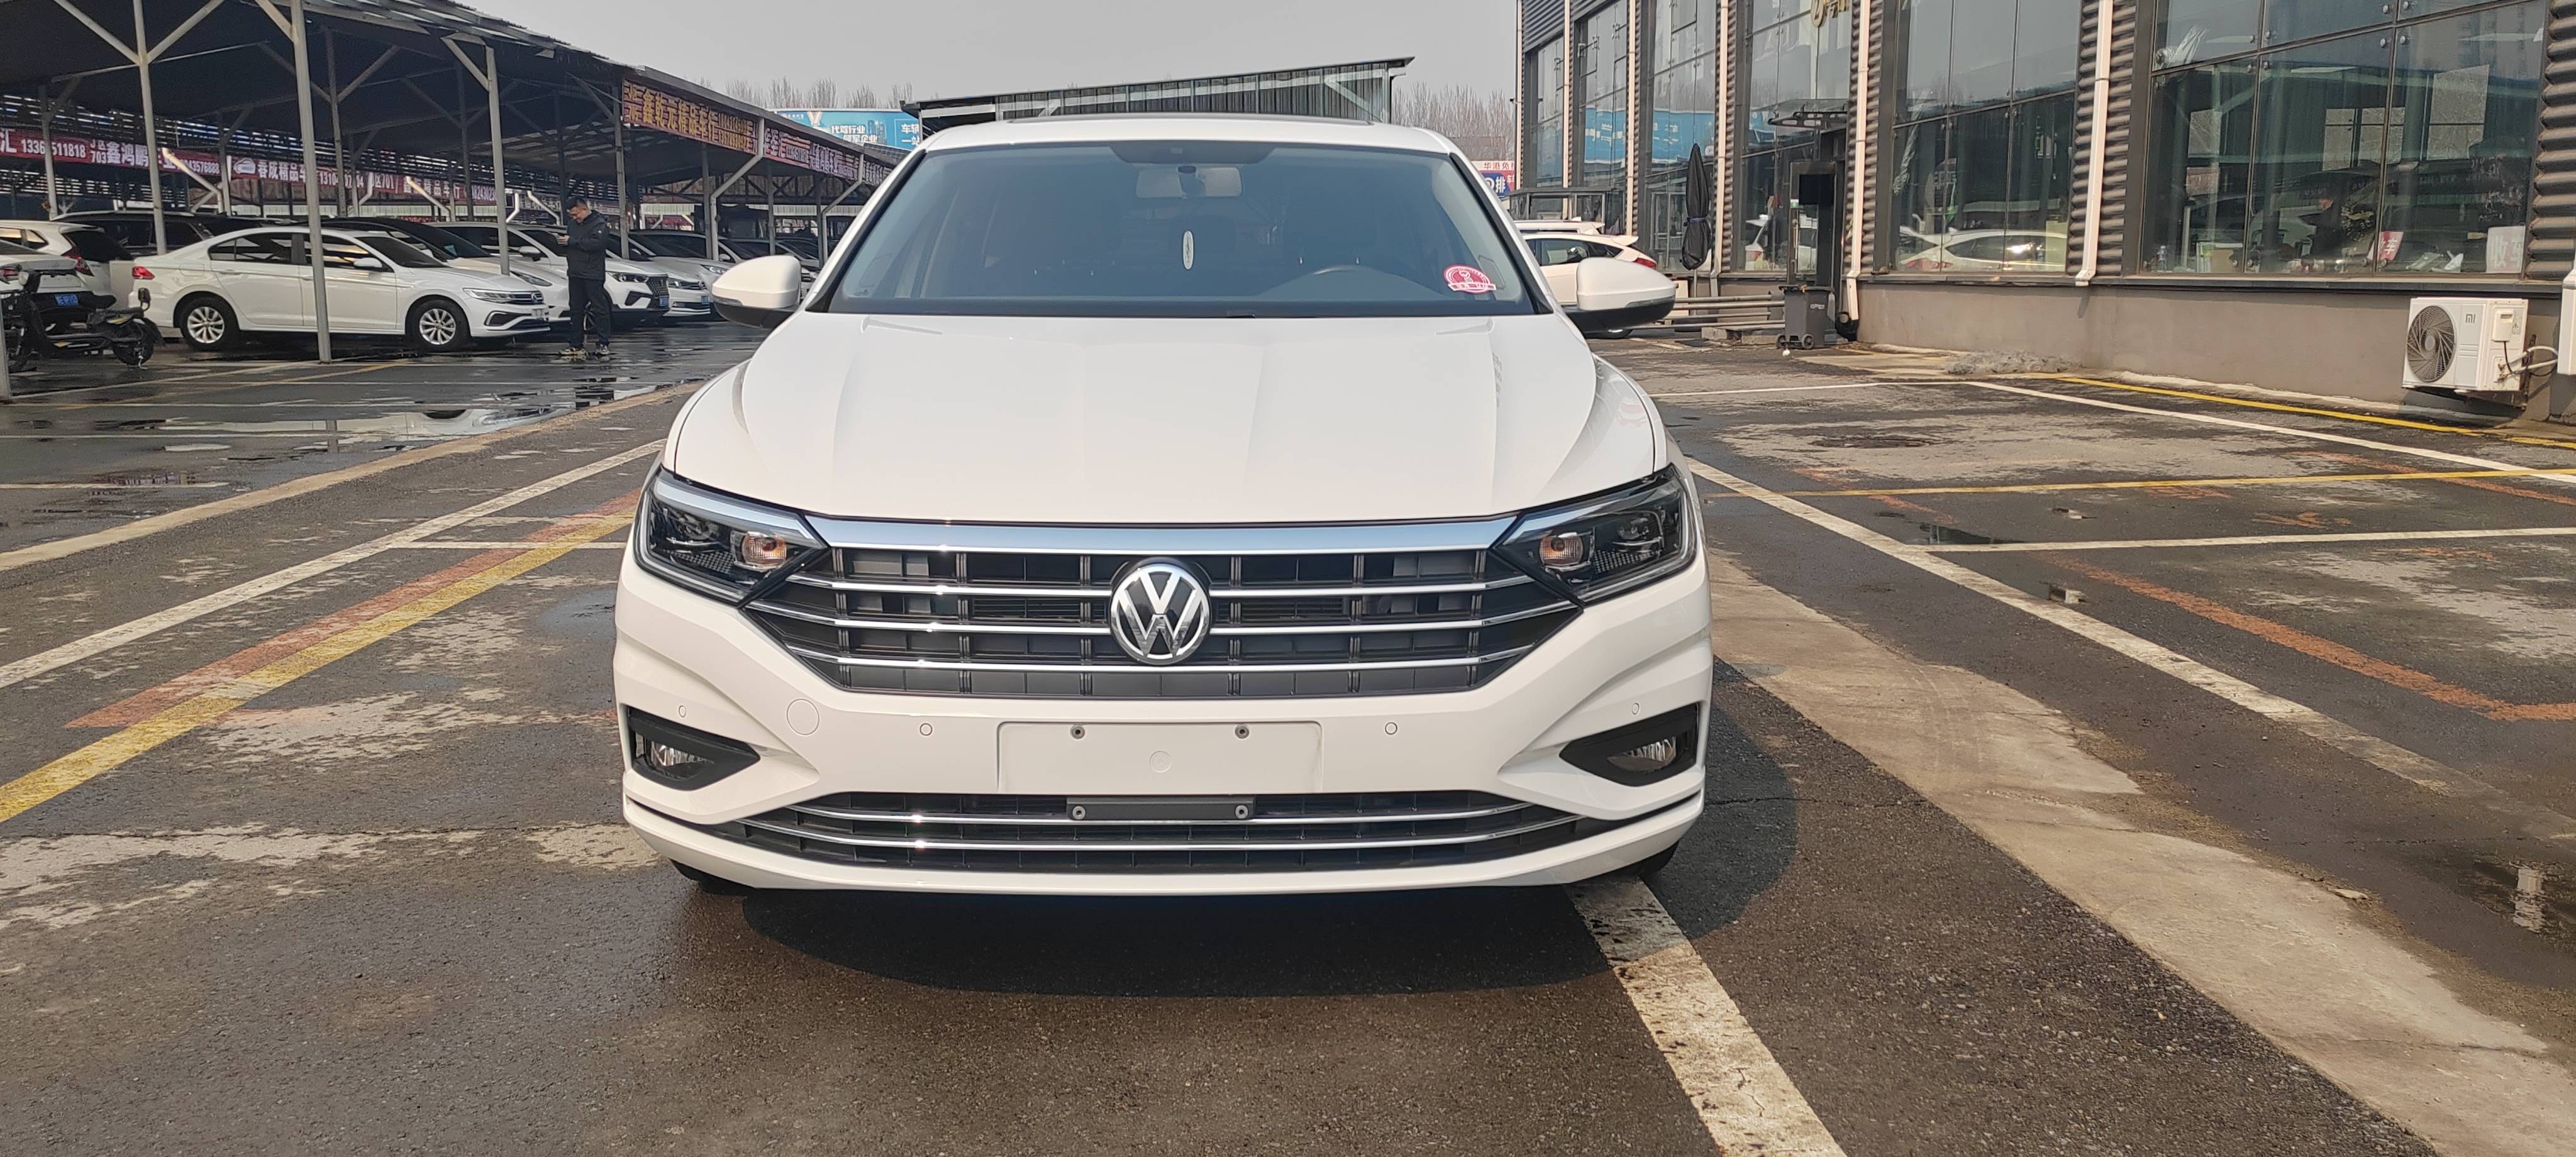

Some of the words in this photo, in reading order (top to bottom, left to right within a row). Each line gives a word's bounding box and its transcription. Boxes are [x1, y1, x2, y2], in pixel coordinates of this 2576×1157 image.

[21, 138, 86, 158] 1336511818
[90, 150, 107, 163] 703
[258, 159, 306, 183] 春成精品车
[403, 175, 460, 199] 鑫精品车行
